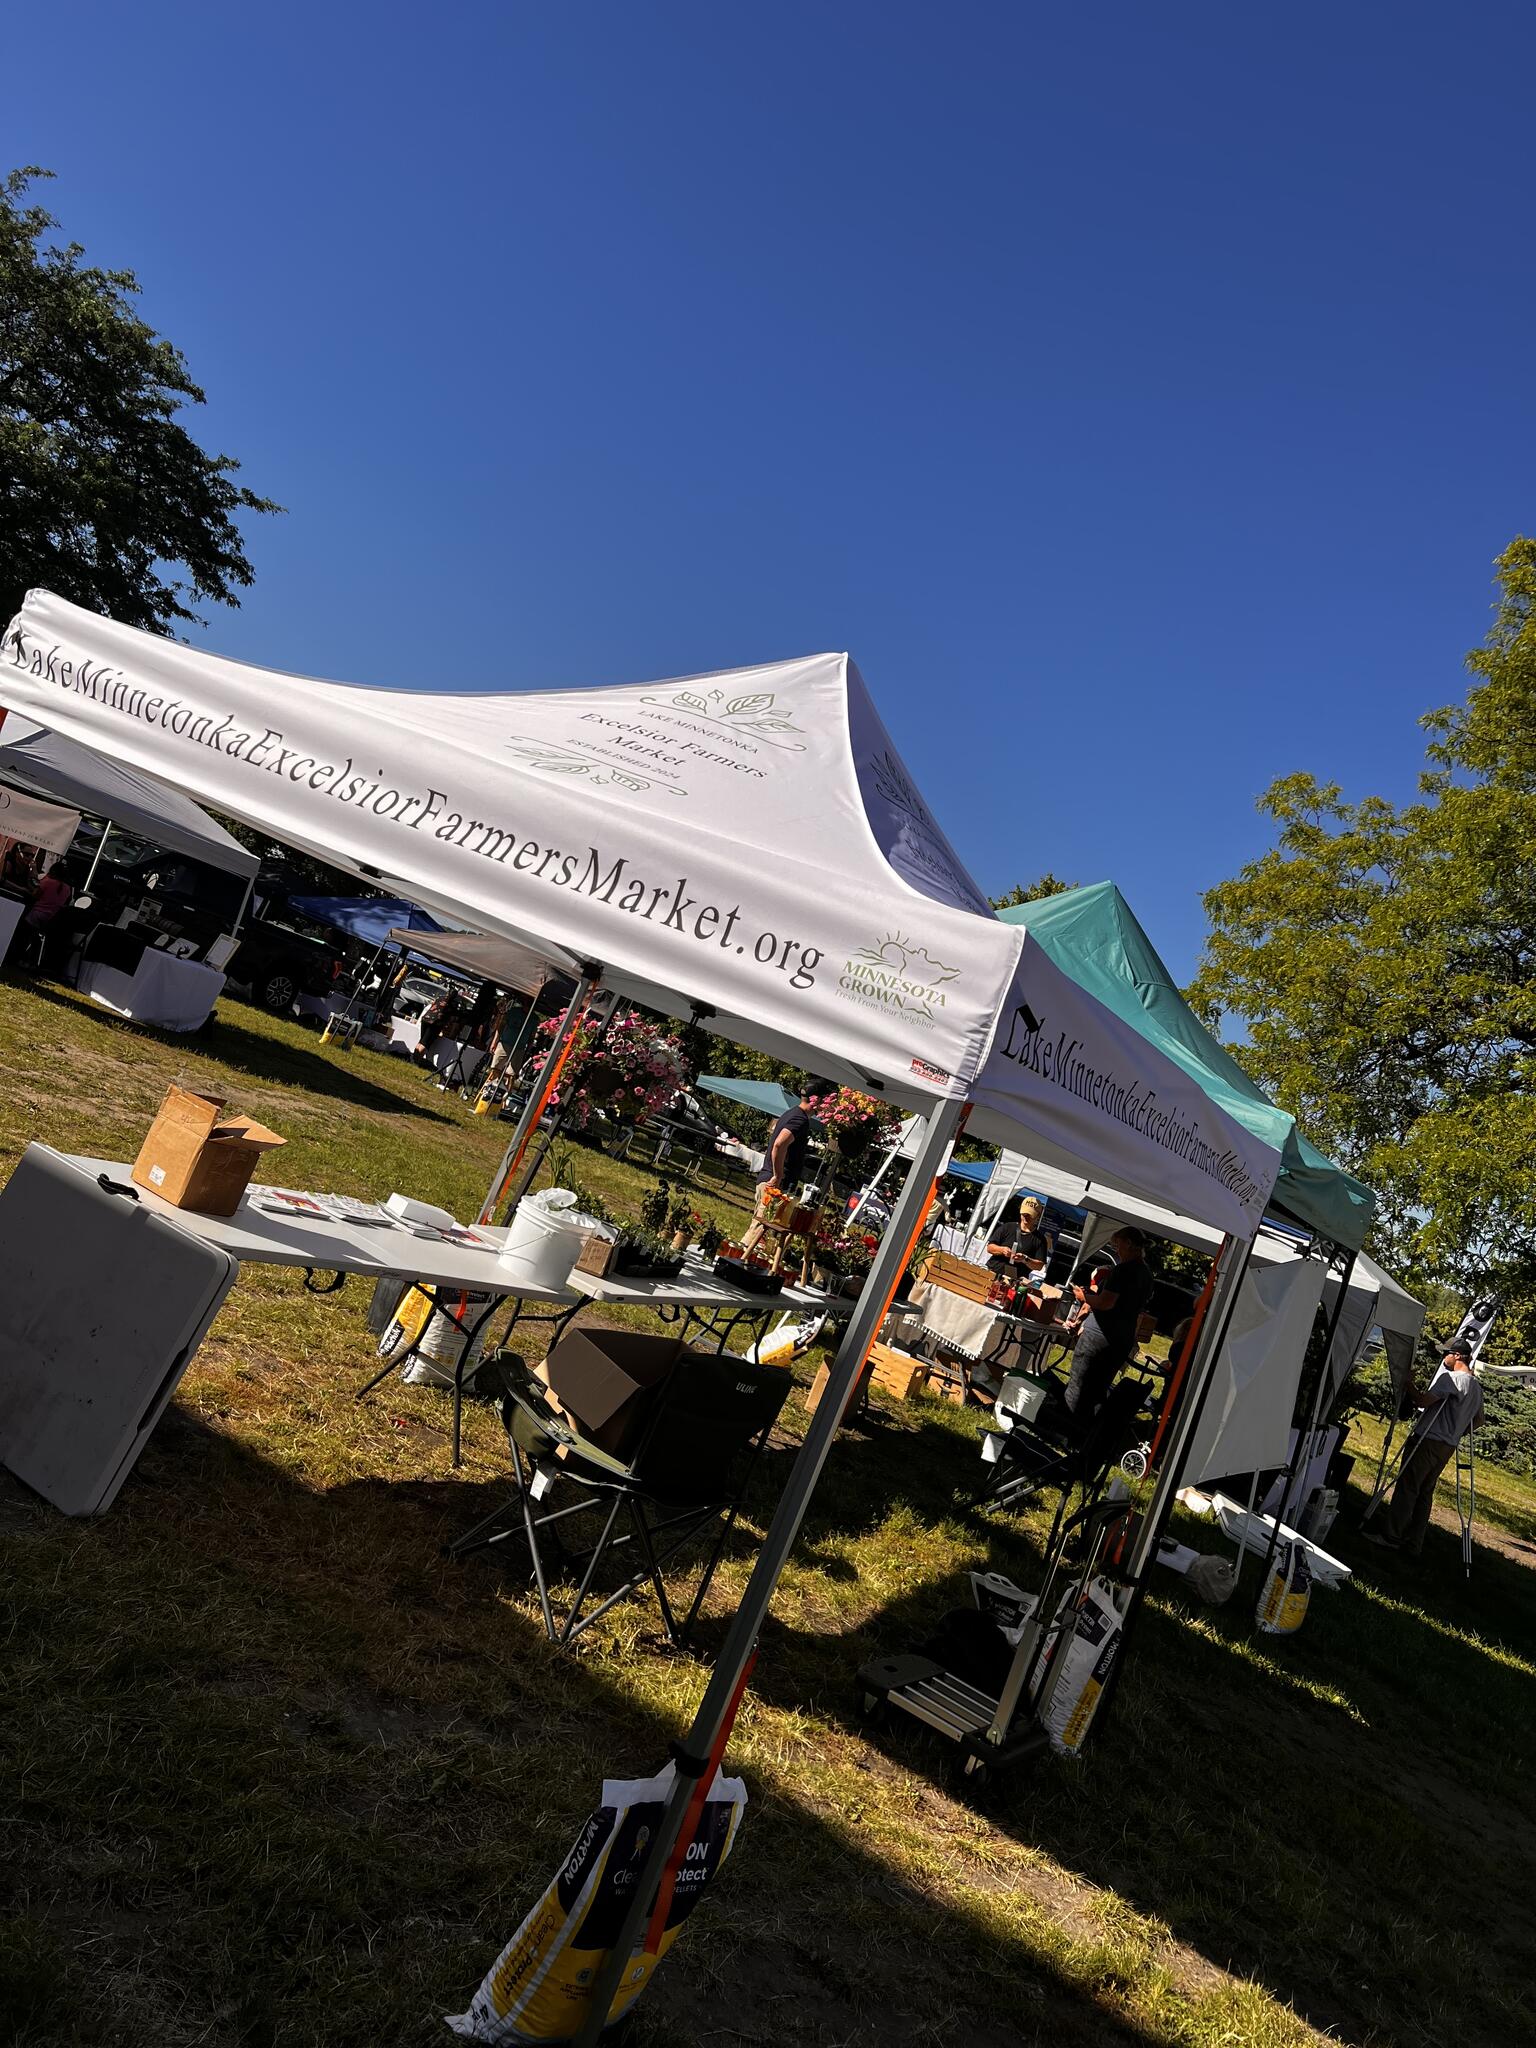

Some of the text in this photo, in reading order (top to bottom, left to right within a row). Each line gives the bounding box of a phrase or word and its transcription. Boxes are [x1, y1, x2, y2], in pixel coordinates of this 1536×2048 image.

[578, 712, 769, 779] Excelsior Farmers
[606, 735, 688, 767] Market
[638, 710, 759, 754] LAKE MINNETONKA
[566, 738, 681, 780] ESTABLISHED 2024
[838, 975, 907, 1009] GROWN
[842, 961, 947, 1007] MINNESOTA
[857, 996, 879, 1013] From
[879, 1003, 897, 1018] Your
[900, 1010, 937, 1032] Neighbor
